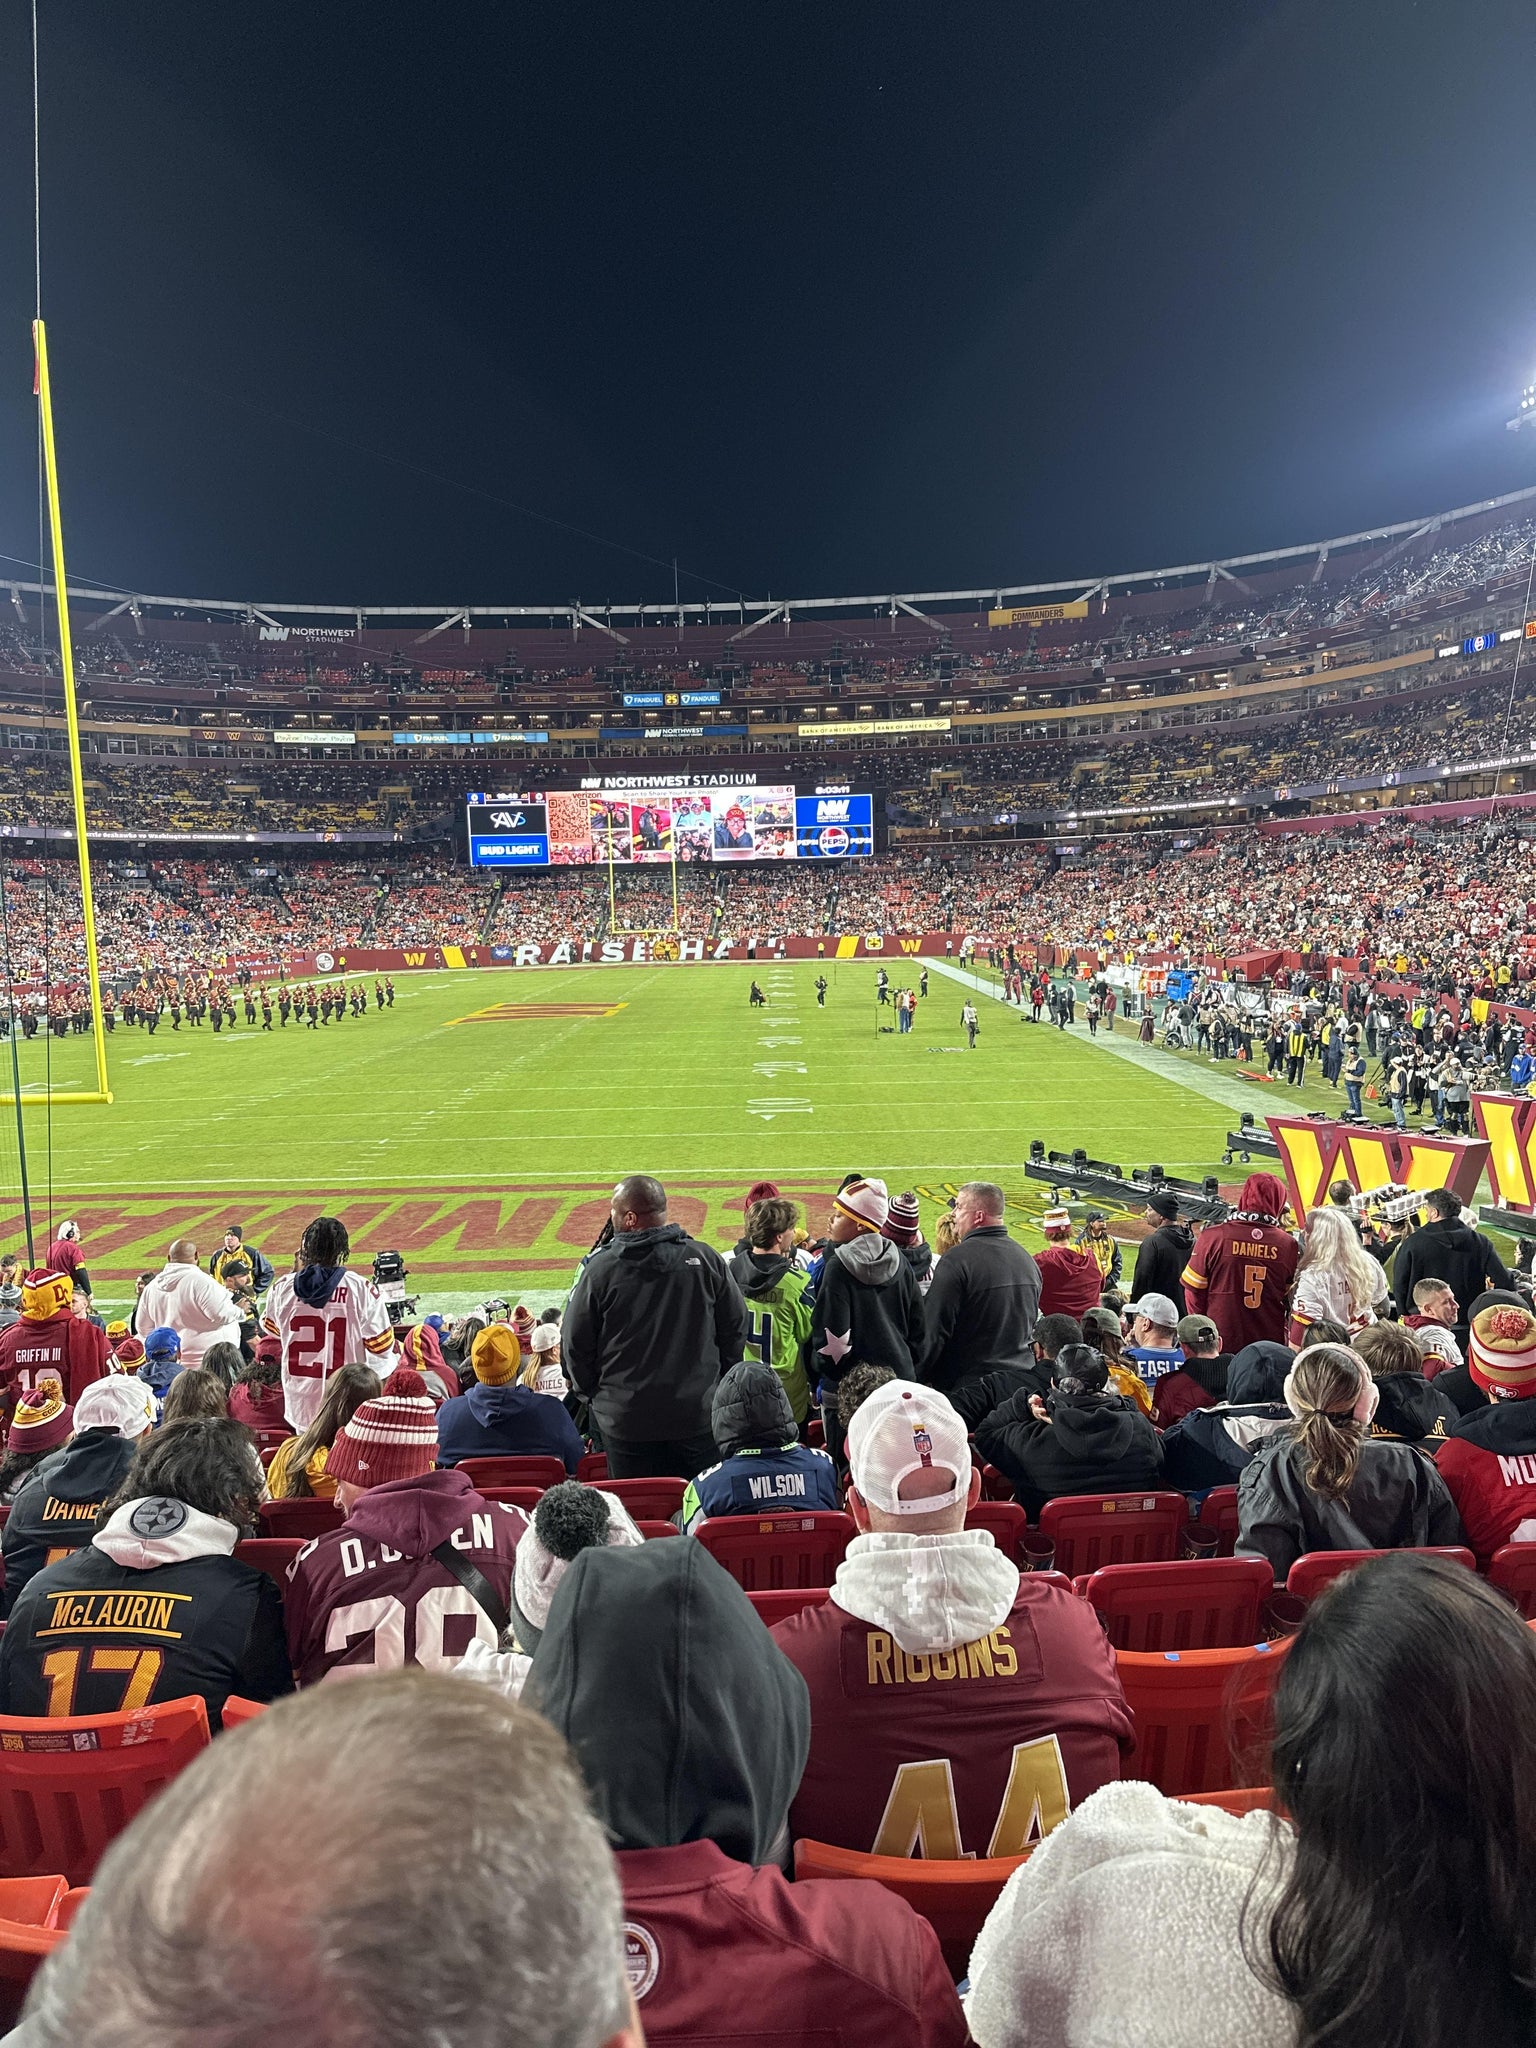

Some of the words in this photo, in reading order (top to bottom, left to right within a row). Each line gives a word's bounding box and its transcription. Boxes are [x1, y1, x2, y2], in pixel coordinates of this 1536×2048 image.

[1012, 608, 1064, 621] COMMANDERS
[260, 627, 289, 641] NW
[292, 628, 355, 637] NORTHWEST
[666, 694, 678, 704] 25
[604, 776, 690, 789] NORTHWEST
[694, 774, 757, 785] STADIUM
[572, 791, 602, 799] verizon
[480, 846, 504, 855] BUD
[506, 845, 540, 854] LIGHT
[516, 941, 654, 966] RAISE
[745, 1097, 814, 1114] 10
[1232, 1240, 1278, 1260] DANIELS
[1244, 1265, 1267, 1309] 5
[16, 1348, 50, 1363] GRIFFIN
[52, 1348, 62, 1361] III
[288, 1315, 347, 1380] 21
[106, 1353, 121, 1374] 10
[534, 1379, 563, 1391] ANIELS
[917, 1441, 930, 1451] NFL
[748, 1473, 806, 1499] WILSON
[50, 1596, 174, 1630] McLAURIN
[867, 1625, 1019, 1684] RIGGINS
[41, 1647, 165, 1717] 17
[870, 1733, 1073, 1861] 44
